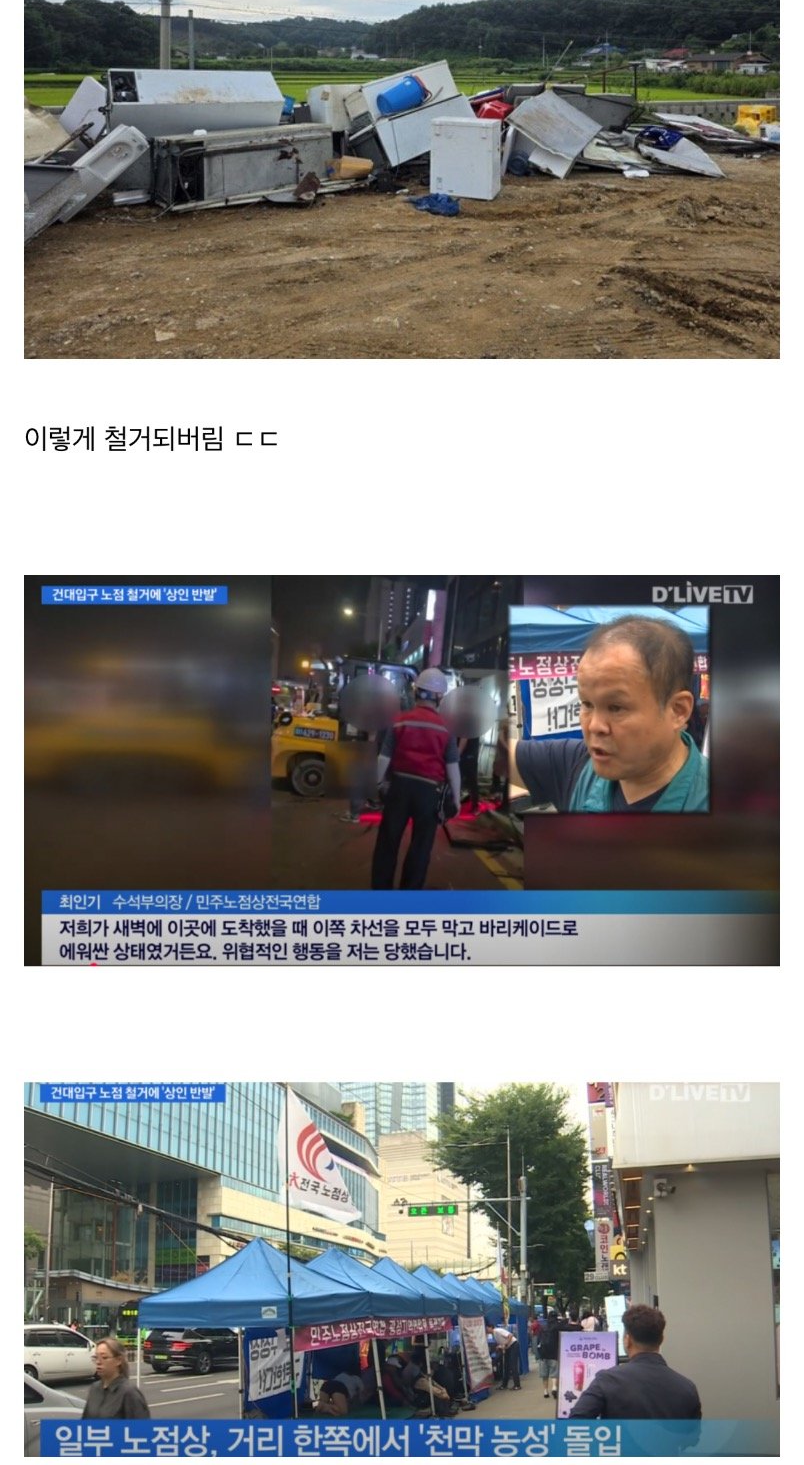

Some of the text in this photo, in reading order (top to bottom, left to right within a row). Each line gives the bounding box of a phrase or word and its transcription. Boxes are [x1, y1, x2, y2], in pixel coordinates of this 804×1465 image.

[613, 1264, 627, 1275] kt
[570, 1344, 601, 1352] GRAPE
[582, 1352, 611, 1360] BOMB
